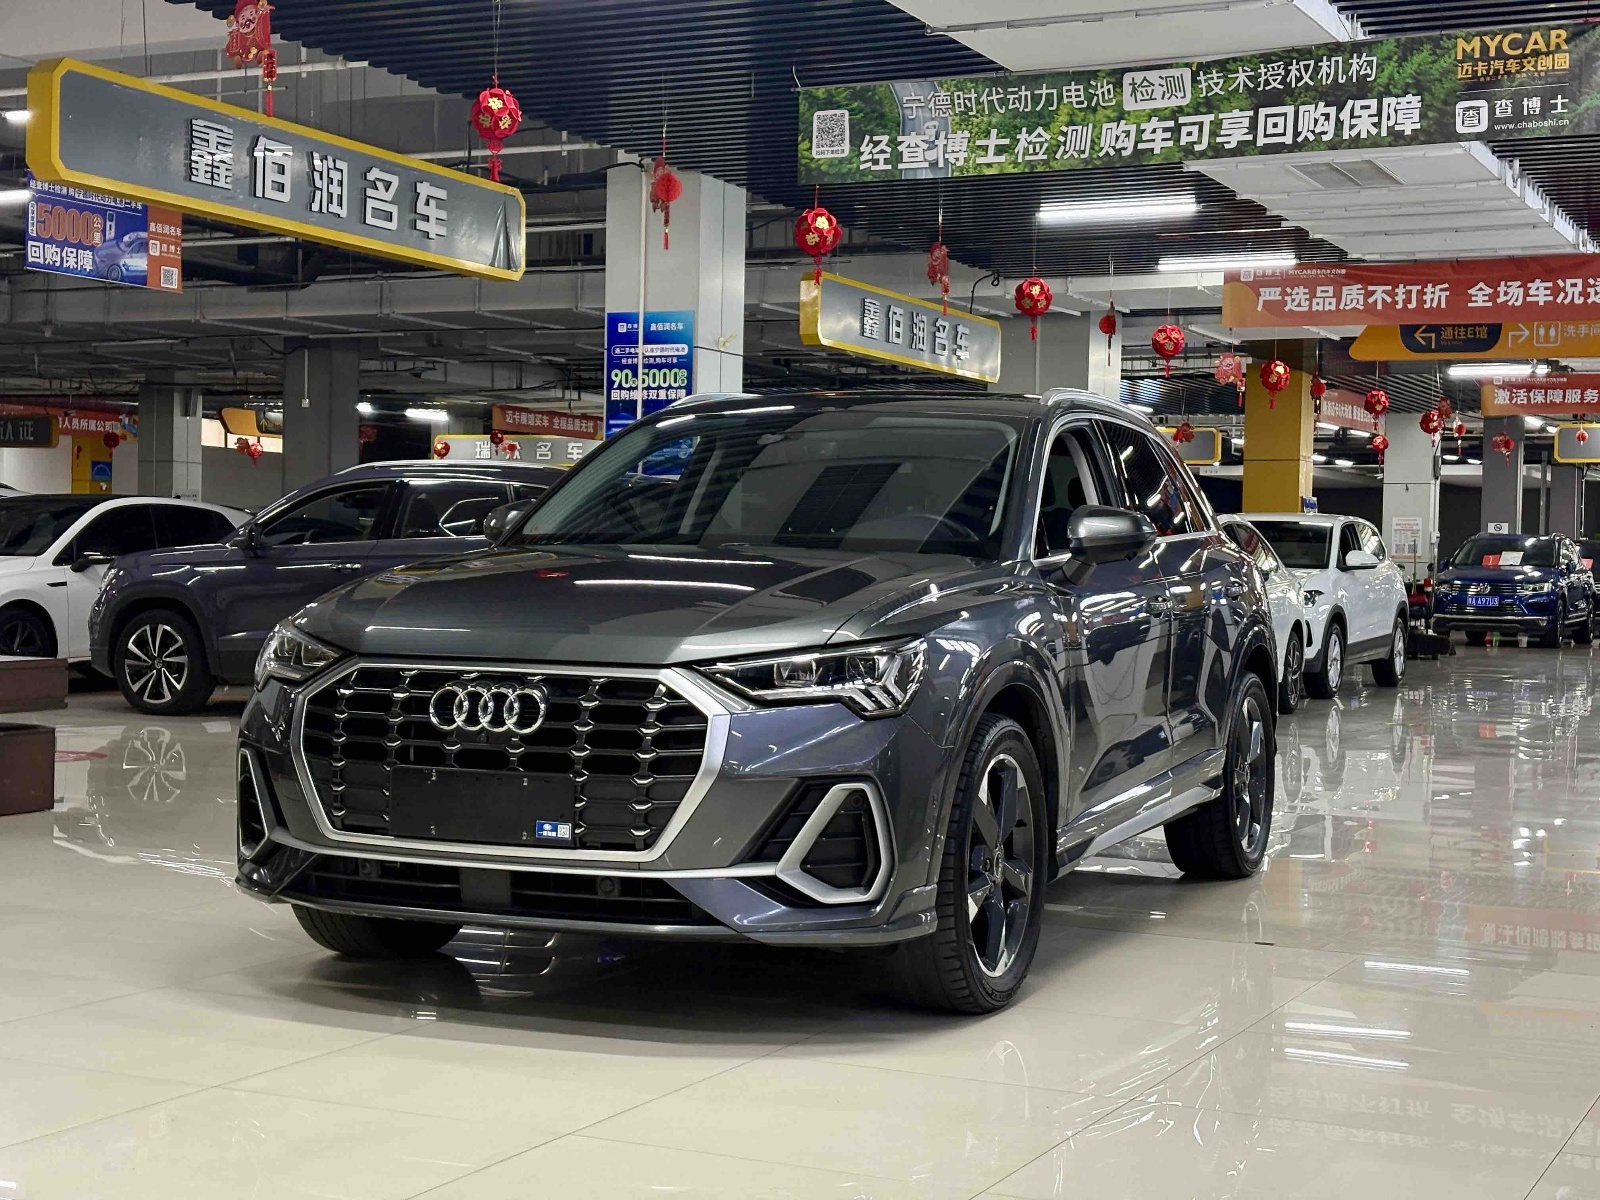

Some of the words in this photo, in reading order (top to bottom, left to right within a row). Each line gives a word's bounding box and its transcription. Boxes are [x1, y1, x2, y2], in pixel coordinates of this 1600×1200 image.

[1456, 29, 1569, 60] MYCAR
[1457, 53, 1570, 79] 迈卡汽车文创园
[902, 81, 1116, 120] 宁德时代动力电池
[1128, 74, 1187, 103] 检测
[1196, 53, 1377, 97] 技术授权机构
[1494, 95, 1569, 117] 查博士
[859, 94, 1422, 171] 经查博士检测购车可享回购保障
[1494, 118, 1570, 131] www.chaboshi.cn
[190, 117, 447, 241] 鑫佰润名车
[27, 240, 94, 272] 回购保障
[1257, 282, 1449, 312] 严选品质不打折
[862, 298, 970, 361] 鑫佰润名车
[1440, 325, 1488, 340] 通往E馆
[1494, 388, 1599, 405] 激活保障服务
